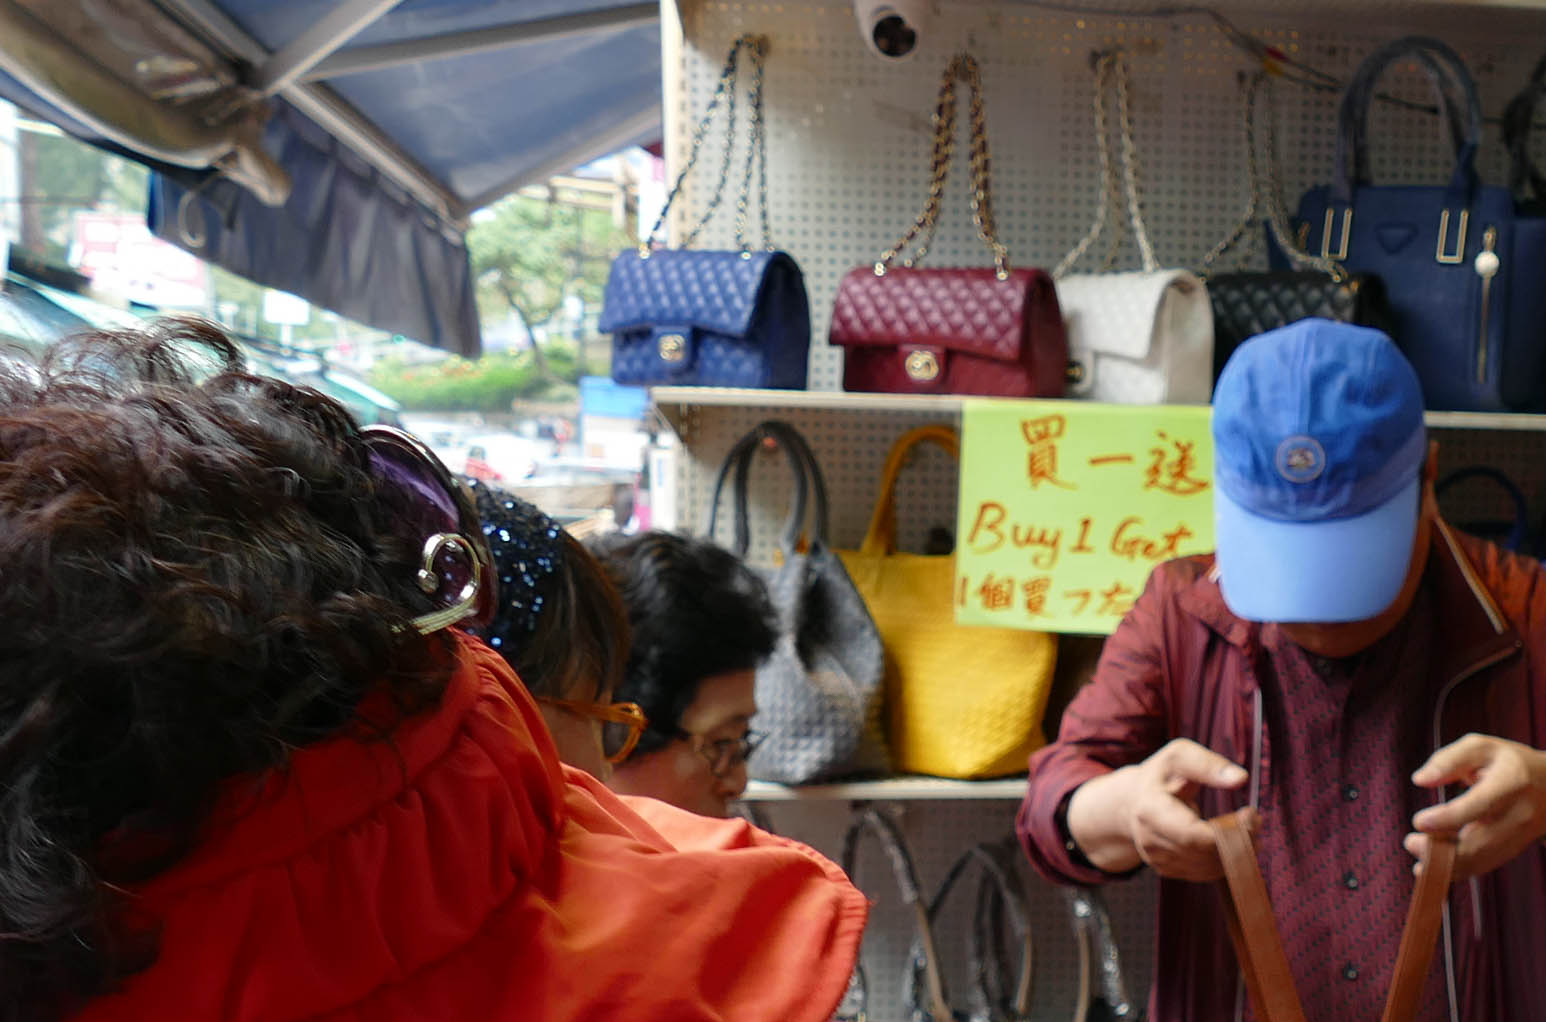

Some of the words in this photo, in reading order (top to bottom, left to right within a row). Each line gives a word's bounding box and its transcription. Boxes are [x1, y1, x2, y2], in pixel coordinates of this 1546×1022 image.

[967, 500, 1064, 570] Buy
[1068, 517, 1094, 554] 1
[1111, 516, 1194, 560] Get
